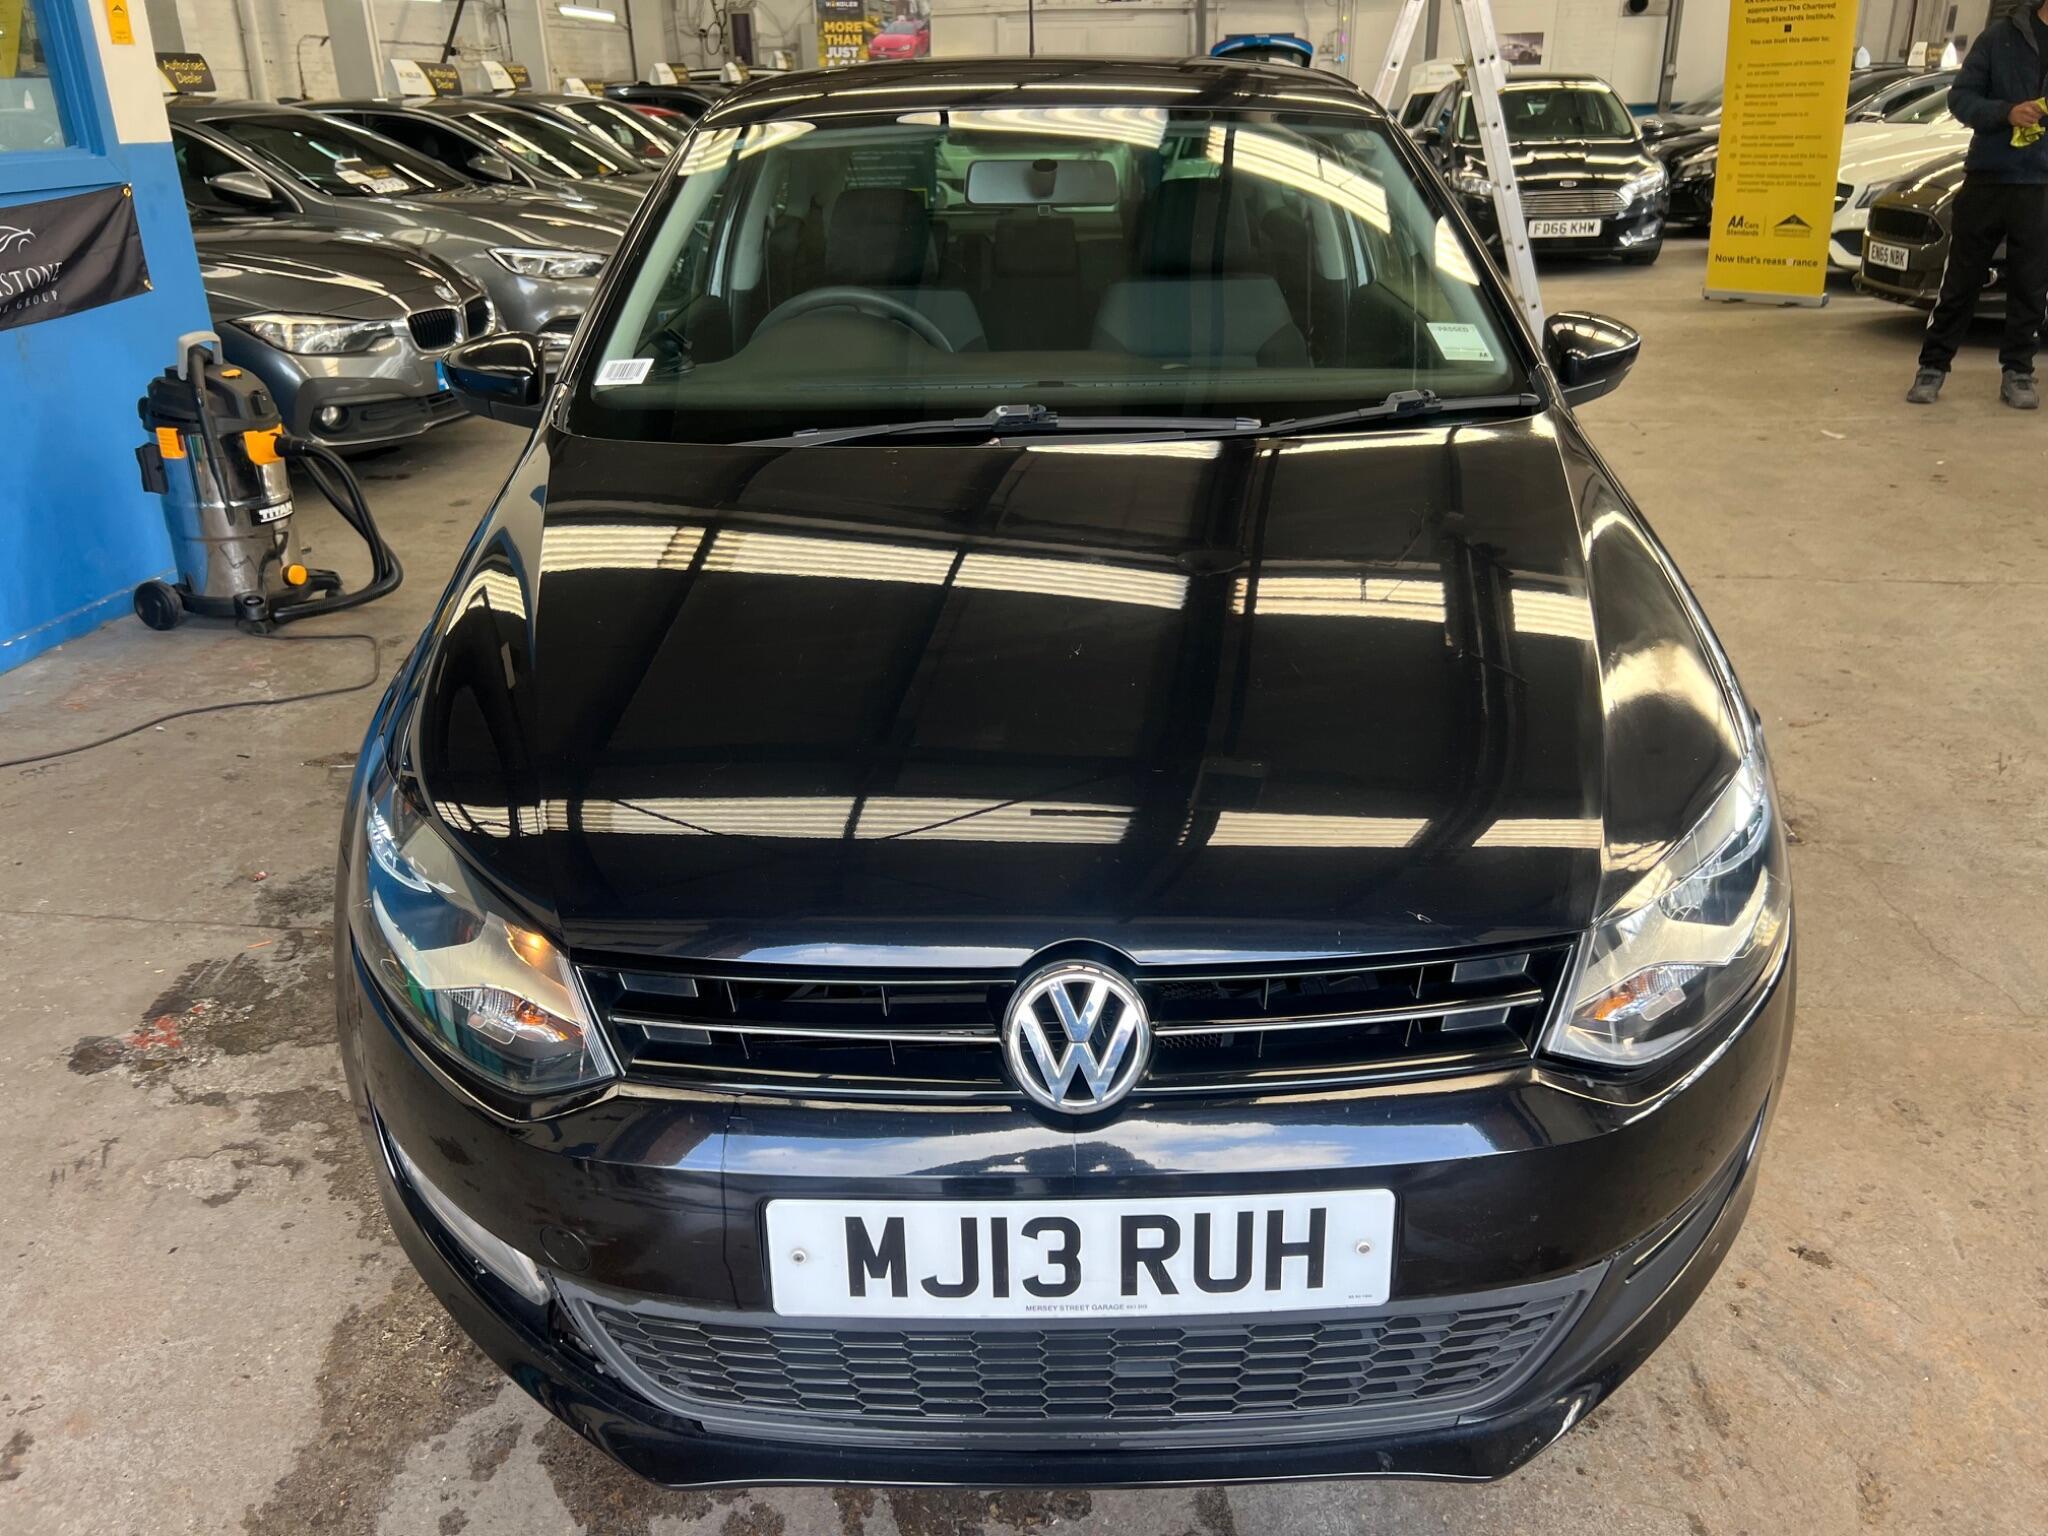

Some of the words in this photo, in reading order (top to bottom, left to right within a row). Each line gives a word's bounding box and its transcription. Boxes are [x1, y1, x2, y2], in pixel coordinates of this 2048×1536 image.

[1802, 2, 1836, 10] Chartered
[824, 21, 862, 32] MORE
[824, 34, 862, 45] THAN
[826, 47, 859, 58] JUST
[163, 59, 206, 70] Authorised
[175, 71, 203, 84] Dealer
[1728, 215, 1744, 228] AA
[1534, 222, 1567, 235] FD66
[1570, 221, 1596, 233] KHW
[1715, 254, 1735, 263] Now
[1736, 255, 1761, 265] that's
[0, 262, 62, 297] STONE
[16, 290, 58, 310] GROUP
[258, 500, 292, 519] TITAN
[844, 1215, 1082, 1298] MJ13
[1120, 1206, 1328, 1297] RUH
[1025, 1304, 1057, 1313] MERSEY
[1059, 1304, 1089, 1312] STREET
[1091, 1303, 1125, 1311] GARAGE
